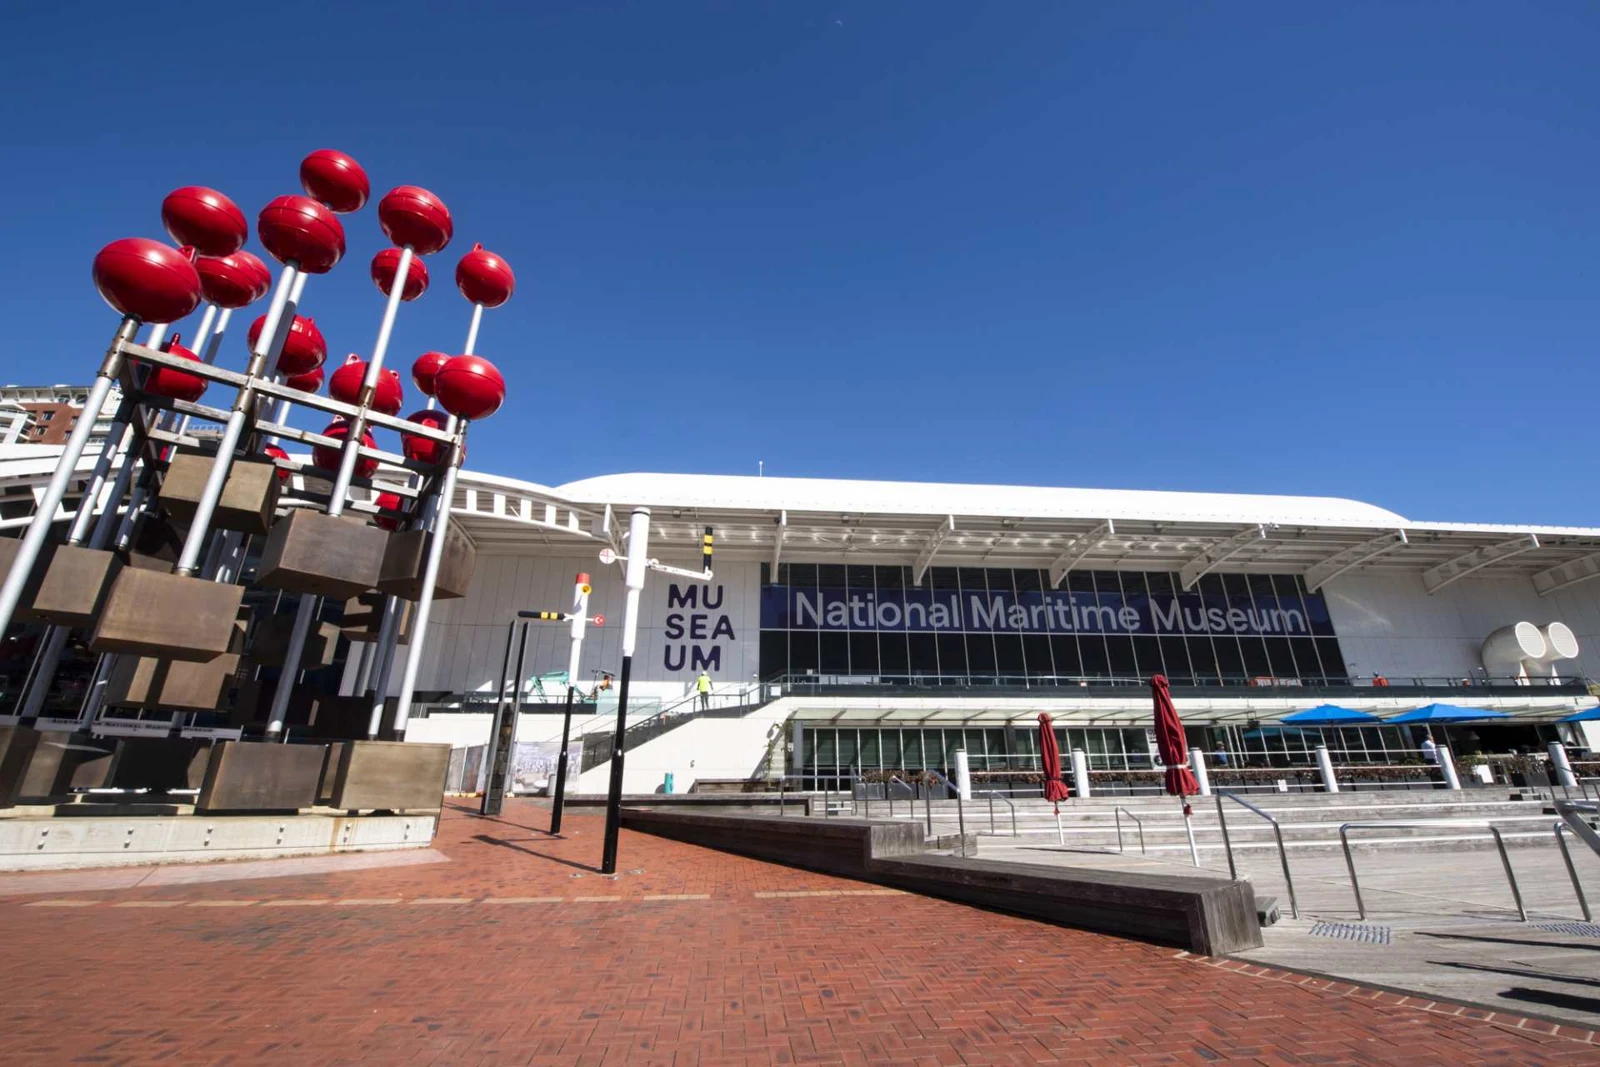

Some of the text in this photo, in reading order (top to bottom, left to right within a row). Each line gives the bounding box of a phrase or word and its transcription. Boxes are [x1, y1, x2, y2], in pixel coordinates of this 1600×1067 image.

[668, 584, 723, 609] MU
[795, 592, 1307, 632] National Maritime Museum
[664, 614, 735, 640] SEA
[664, 645, 721, 671] UM
